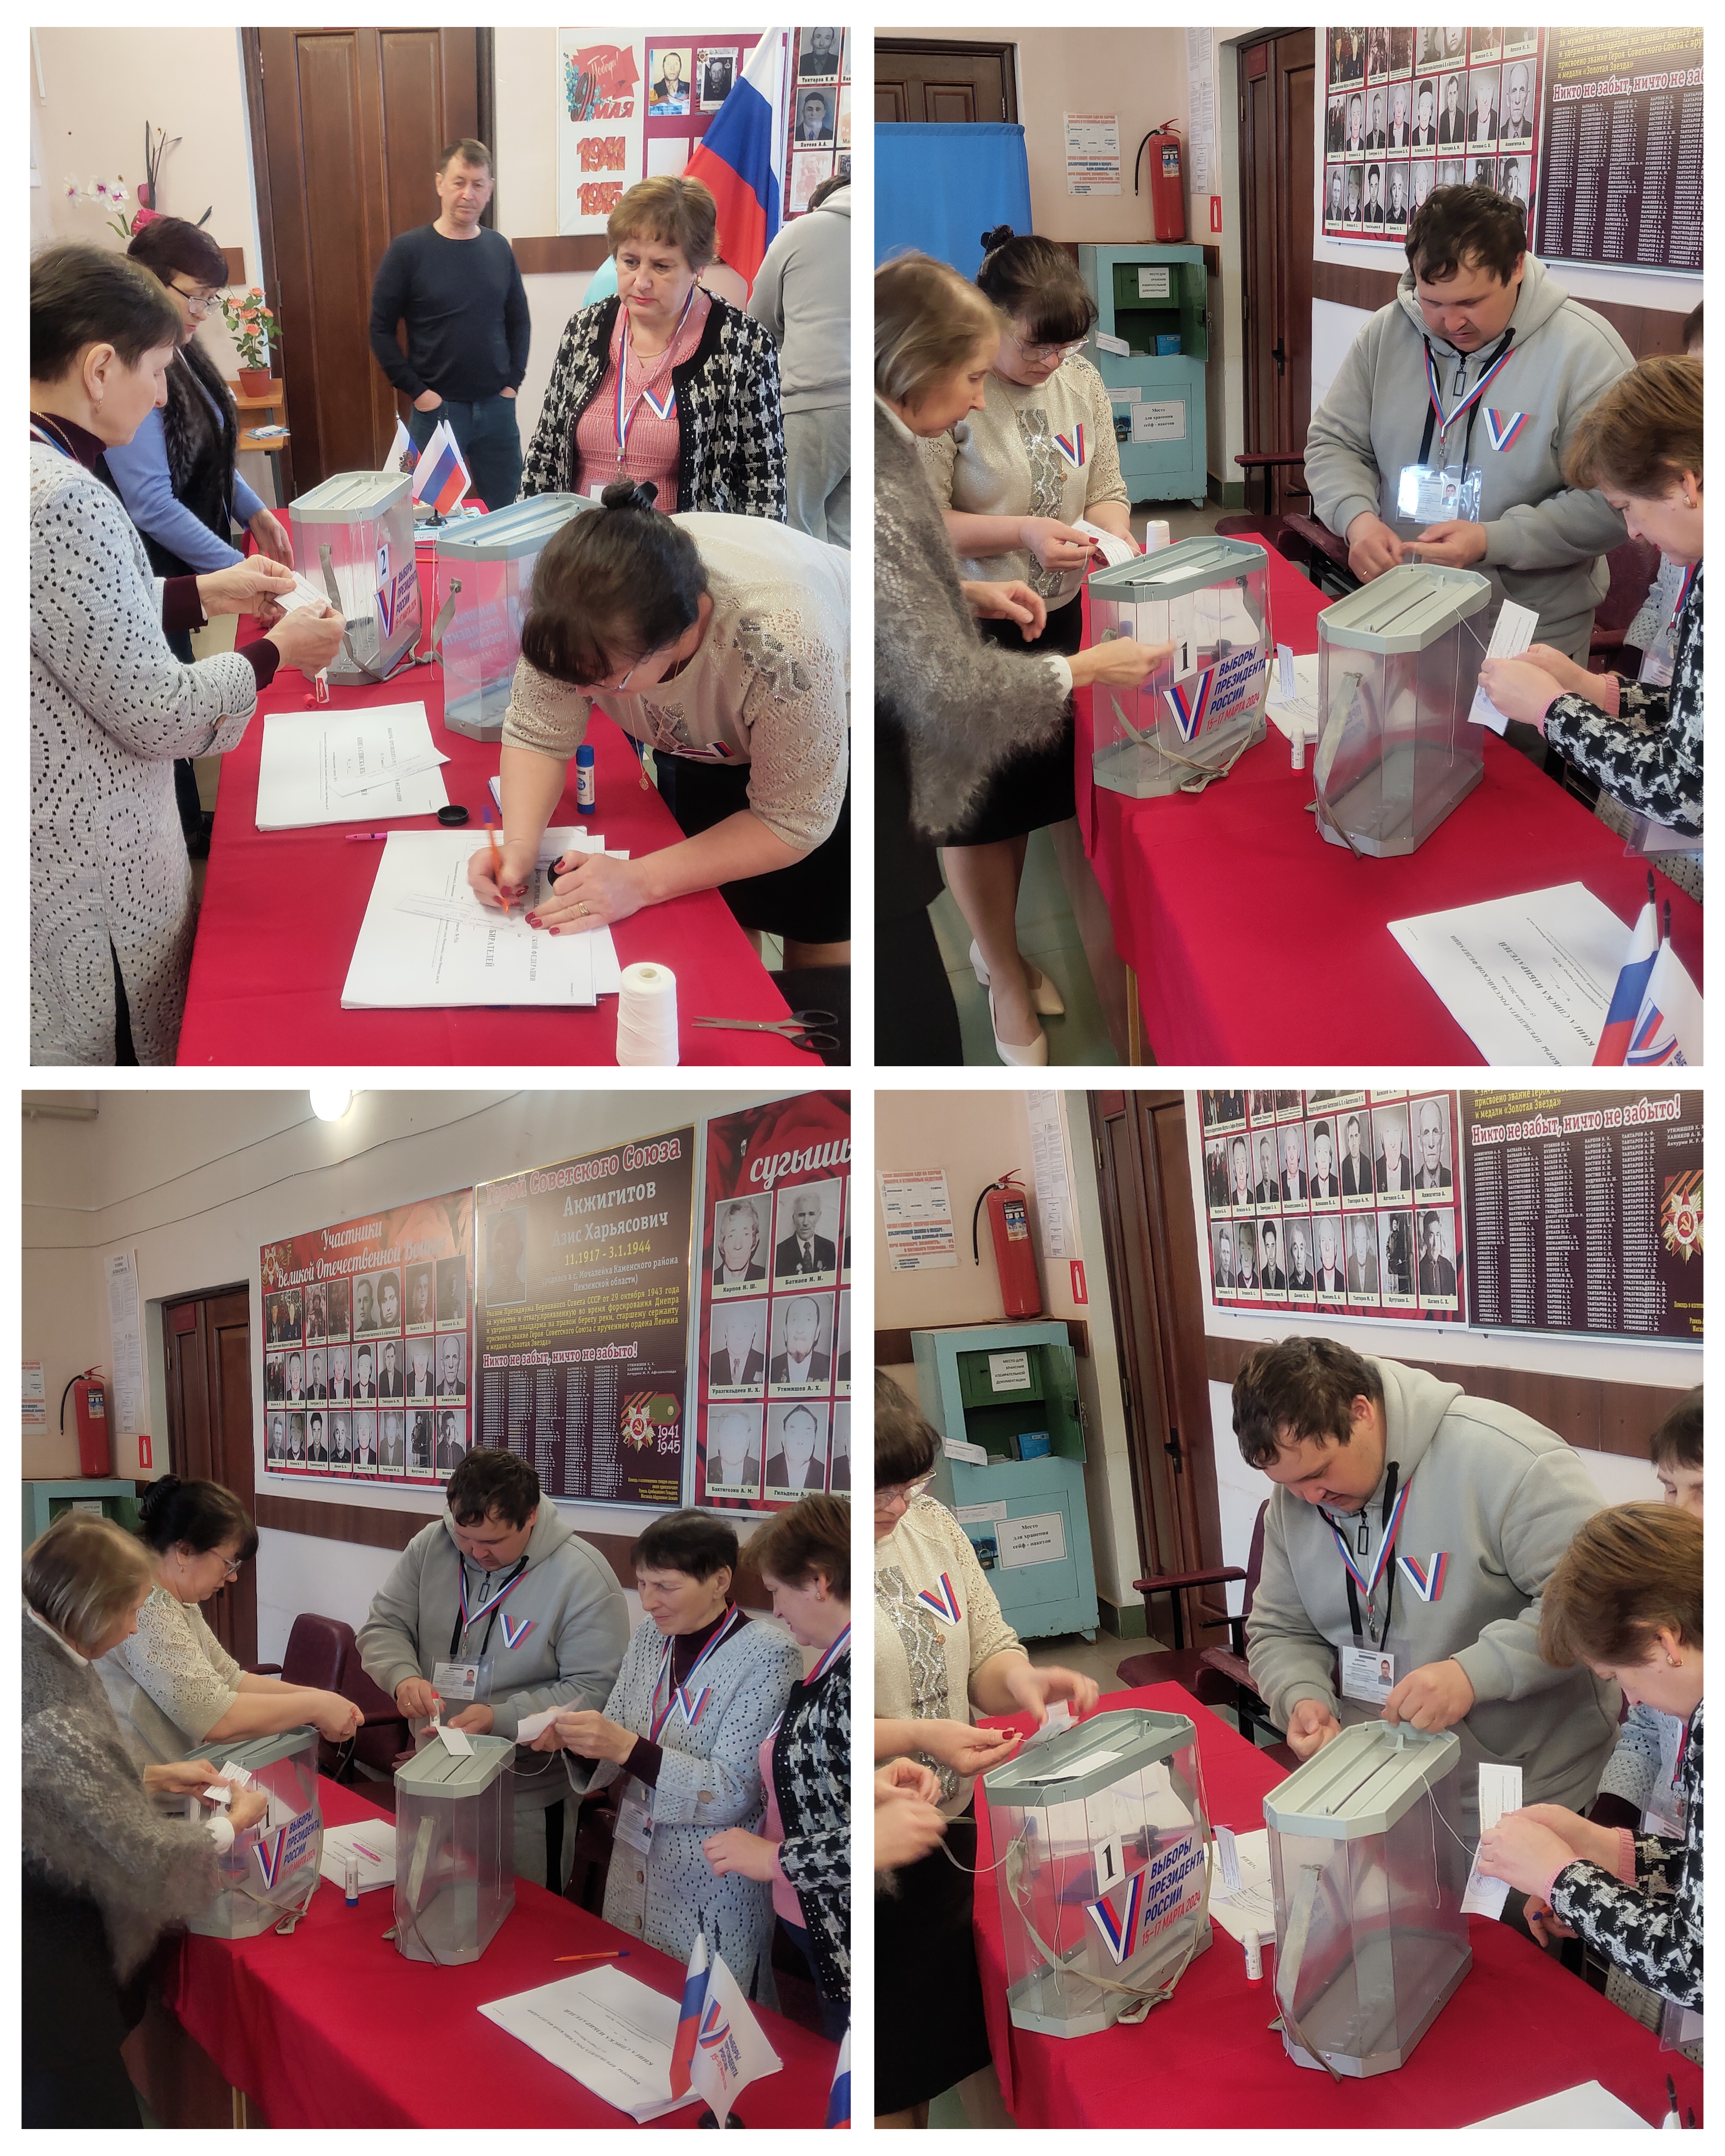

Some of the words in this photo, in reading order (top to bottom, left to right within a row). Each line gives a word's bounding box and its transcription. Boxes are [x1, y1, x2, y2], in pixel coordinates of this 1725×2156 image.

[587, 51, 618, 80] Победа!
[1553, 85, 1581, 101] Никто
[1583, 84, 1596, 96] не
[1598, 77, 1632, 95] забыт,
[1634, 75, 1667, 89] ничто
[1670, 72, 1685, 85] не
[591, 101, 634, 119] МАЯ
[577, 136, 625, 172] 1941
[381, 550, 386, 576] 2
[398, 559, 413, 584] ВЫБОРЫ
[396, 592, 410, 616] РОССИИ
[1180, 640, 1190, 672] 1
[1219, 646, 1257, 677] ВЫБОРЫ
[1214, 657, 1266, 696] ПРЕЗИДЕНТА
[1210, 684, 1245, 715] РОССИИ
[1224, 701, 1245, 721] МАРТА
[1246, 691, 1260, 709] 2024
[485, 929, 497, 967] БИРАТЕЛЕЙ
[1450, 935, 1477, 965] ФЕДЕРАЦИИ
[529, 950, 537, 982] ФЕДЕРАЦИИ
[1498, 941, 1544, 989] ИЗБИРАТЕЛЕЙ
[1476, 965, 1509, 1006] РОССИЙСКОЙ
[1542, 990, 1571, 1018] СПИСКА
[1508, 1007, 1542, 1043] ПРЕЗИДЕНТА
[1570, 1019, 1595, 1047] КНИГА
[1541, 1046, 1562, 1066] БОРЫ
[1472, 1124, 1504, 1144] Никто
[1506, 1123, 1521, 1137] не
[1523, 1113, 1562, 1137] забыт,
[1565, 1113, 1601, 1131] ничто
[1605, 1110, 1621, 1125] не
[1624, 1093, 1681, 1122] забыто!
[486, 1175, 527, 1206] Герой
[530, 1155, 619, 1195] Советского
[623, 1139, 681, 1171] Союза
[563, 1181, 656, 1217] Акжигитов
[321, 1221, 382, 1251] Участники
[553, 1229, 582, 1246] Азис
[585, 1211, 669, 1243] Харьясович
[277, 1261, 315, 1289] Великой
[317, 1241, 401, 1279] Отечественной
[565, 1249, 599, 1266] 11.1917
[609, 1239, 652, 1258] 3.1.1944
[614, 1260, 652, 1274] Каменского
[653, 1256, 678, 1269] района
[574, 1279, 609, 1291] Пензенской
[610, 1274, 638, 1286] области)
[536, 1302, 566, 1311] Верховного
[567, 1298, 585, 1306] Совета
[587, 1295, 601, 1304] СССР
[620, 1290, 645, 1301] октября
[647, 1288, 663, 1297] 1943
[665, 1286, 680, 1296] года
[588, 1306, 606, 1316] время
[608, 1300, 652, 1313] форсирования
[655, 1296, 679, 1307] Днепра
[486, 1334, 511, 1343] присвоено
[529, 1331, 544, 1339] Героя
[545, 1328, 574, 1337] Советского
[575, 1326, 593, 1334] Союза
[597, 1321, 630, 1333] вручением
[631, 1320, 653, 1329] ордена
[654, 1316, 678, 1326] Ленина
[556, 1319, 577, 1328] правом
[578, 1315, 597, 1325] берегу
[599, 1313, 614, 1323] реки,
[616, 1310, 646, 1321] старшему
[648, 1306, 679, 1318] сержанту
[483, 1355, 508, 1367] Никто
[510, 1356, 520, 1365] не
[522, 1350, 551, 1366] забыт,
[552, 1351, 581, 1363] ничто
[582, 1349, 595, 1361] не
[596, 1342, 638, 1360] забыто!
[508, 1340, 530, 1349] «Золотая
[531, 1339, 552, 1348] Звезда»
[657, 1424, 679, 1441] 1941
[657, 1439, 681, 1455] 1945
[1024, 1531, 1049, 1540] хранения
[1030, 1538, 1052, 1547] пакетов
[286, 1818, 319, 1851] ПРЕЗИДЕНТА
[289, 1809, 313, 1834] ВЫБОРЫ
[283, 1841, 306, 1866] РОССИИ
[1102, 1844, 1117, 1882] 1
[1151, 1836, 1193, 1880] ВЫБОРЫ
[1147, 1849, 1205, 1904] ПРЕЗИДЕНТА
[1144, 1885, 1183, 1927] РОССИИ
[1162, 1903, 1185, 1933] МАРТА
[1185, 1889, 1202, 1914] 2024
[728, 2033, 742, 2061] ВЫБОРЫ
